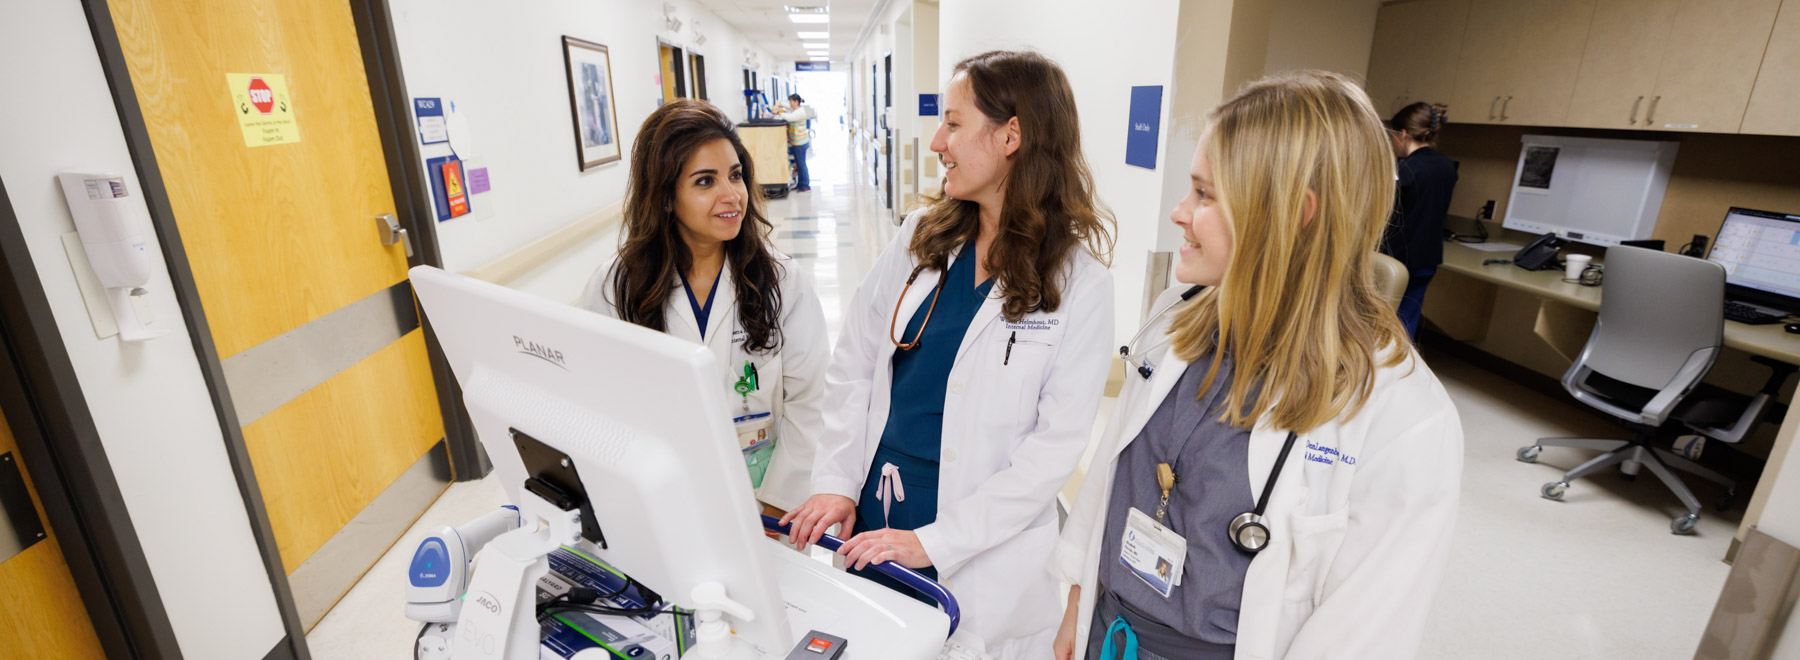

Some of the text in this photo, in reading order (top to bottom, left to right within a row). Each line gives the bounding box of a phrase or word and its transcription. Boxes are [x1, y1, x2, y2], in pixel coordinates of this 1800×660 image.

[250, 89, 272, 103] STOP
[1047, 318, 1059, 326] MD
[512, 335, 566, 365] PLANAR
[1308, 452, 1333, 465] Medicine
[476, 596, 498, 613] JACO
[463, 620, 494, 656] EVO
